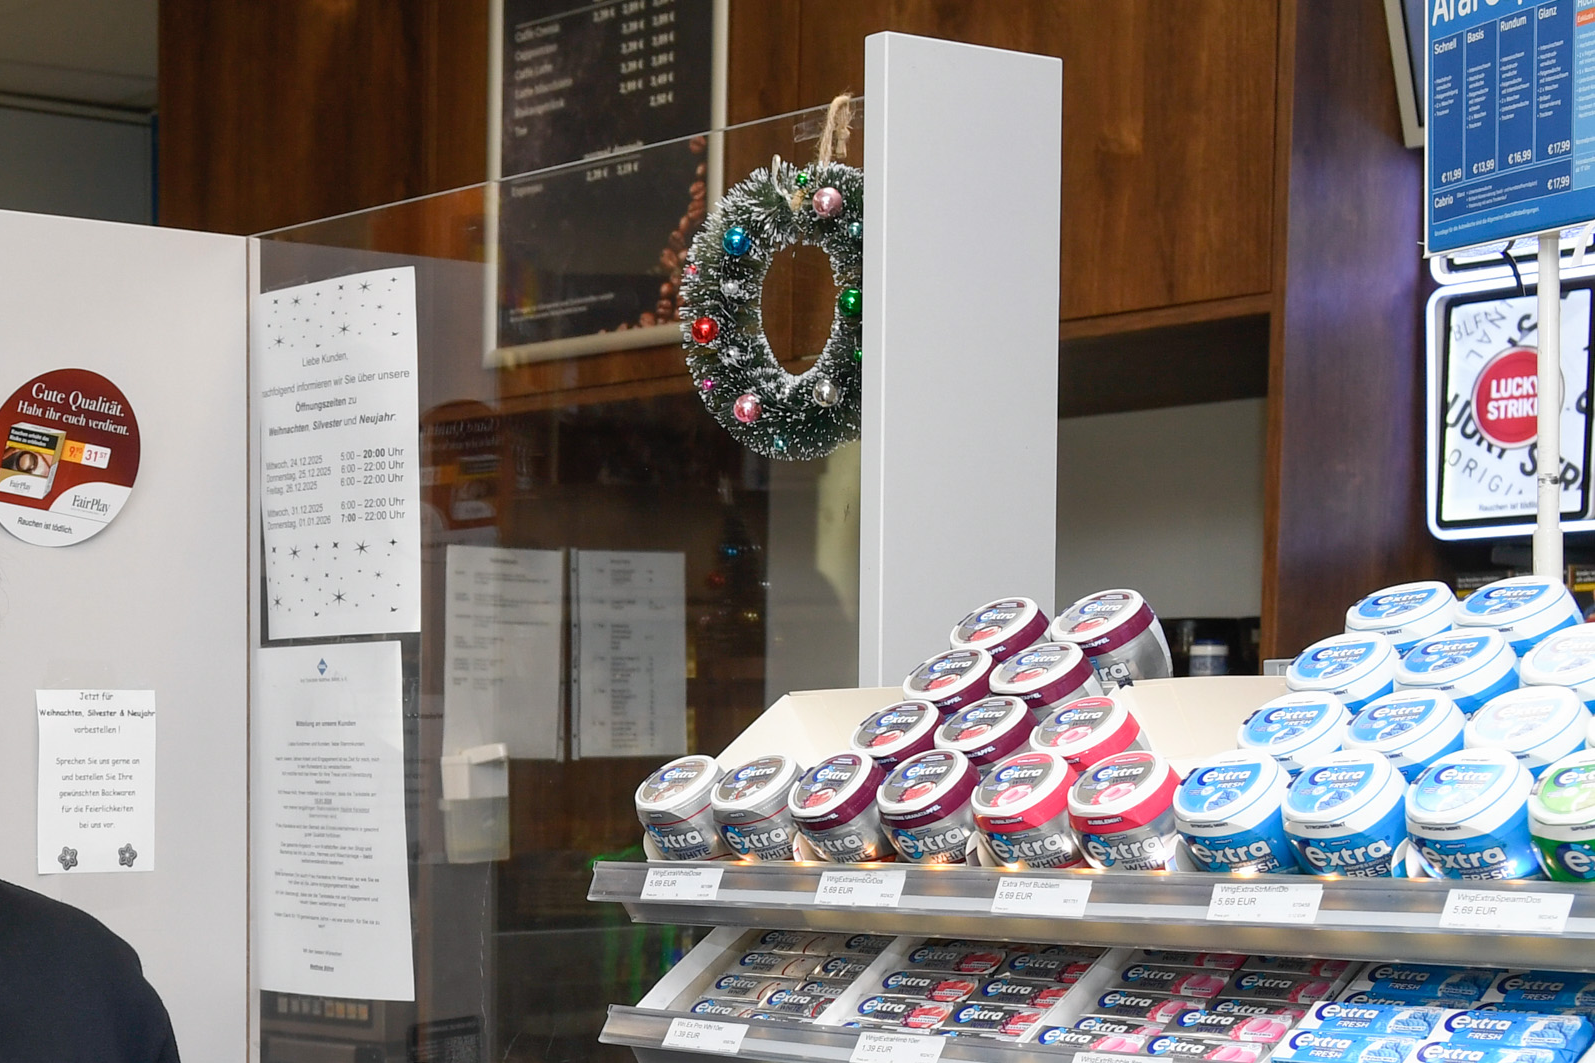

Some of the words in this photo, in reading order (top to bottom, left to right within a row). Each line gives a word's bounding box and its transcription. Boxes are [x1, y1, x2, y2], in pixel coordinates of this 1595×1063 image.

[1538, 6, 1557, 20] Glanz
[1501, 16, 1527, 32] Rundum
[1467, 29, 1484, 43] Basis
[1434, 38, 1456, 54] Schnell
[1434, 195, 1453, 209] Cabrio
[302, 354, 320, 367] Liebe
[321, 352, 348, 364] Kunden,
[296, 380, 332, 392] informieren
[333, 378, 343, 386] wir
[345, 374, 355, 384] Sie
[358, 373, 375, 382] über
[378, 370, 410, 380] unsere
[32, 382, 66, 403] Gute
[69, 391, 124, 417] Qualität.
[17, 400, 43, 417] Habt
[45, 407, 61, 420] ihr
[63, 414, 86, 427] euch
[88, 419, 129, 435] verdient.
[312, 418, 342, 430] Silvester
[85, 450, 97, 462] 31
[363, 448, 385, 458] 20:00
[388, 446, 404, 457] Uhr
[364, 461, 386, 471] 22:00
[388, 460, 404, 470] Uhr
[364, 475, 385, 484] 22:00
[388, 473, 404, 483] Uhr
[72, 495, 110, 516] FairPlay
[364, 498, 386, 508] 22:00
[388, 497, 404, 506] Uhr
[341, 514, 356, 523] 7:00
[365, 511, 387, 521] 22:00
[389, 510, 406, 519] Uhr
[18, 517, 42, 528] Rauchen
[52, 523, 73, 534] tödlich.
[79, 692, 99, 700] Jetzt
[102, 692, 113, 700] für
[39, 709, 84, 718] Weihnachten,
[87, 709, 117, 717] Silvester
[128, 710, 155, 718] Neujahr
[56, 758, 86, 766] Sprechen
[62, 773, 73, 781] und
[59, 789, 99, 798] gewünschten
[62, 805, 72, 813] für
[85, 805, 134, 813] Feierlichkeiten
[1015, 892, 1032, 900] EUR
[1237, 896, 1256, 907] EUR
